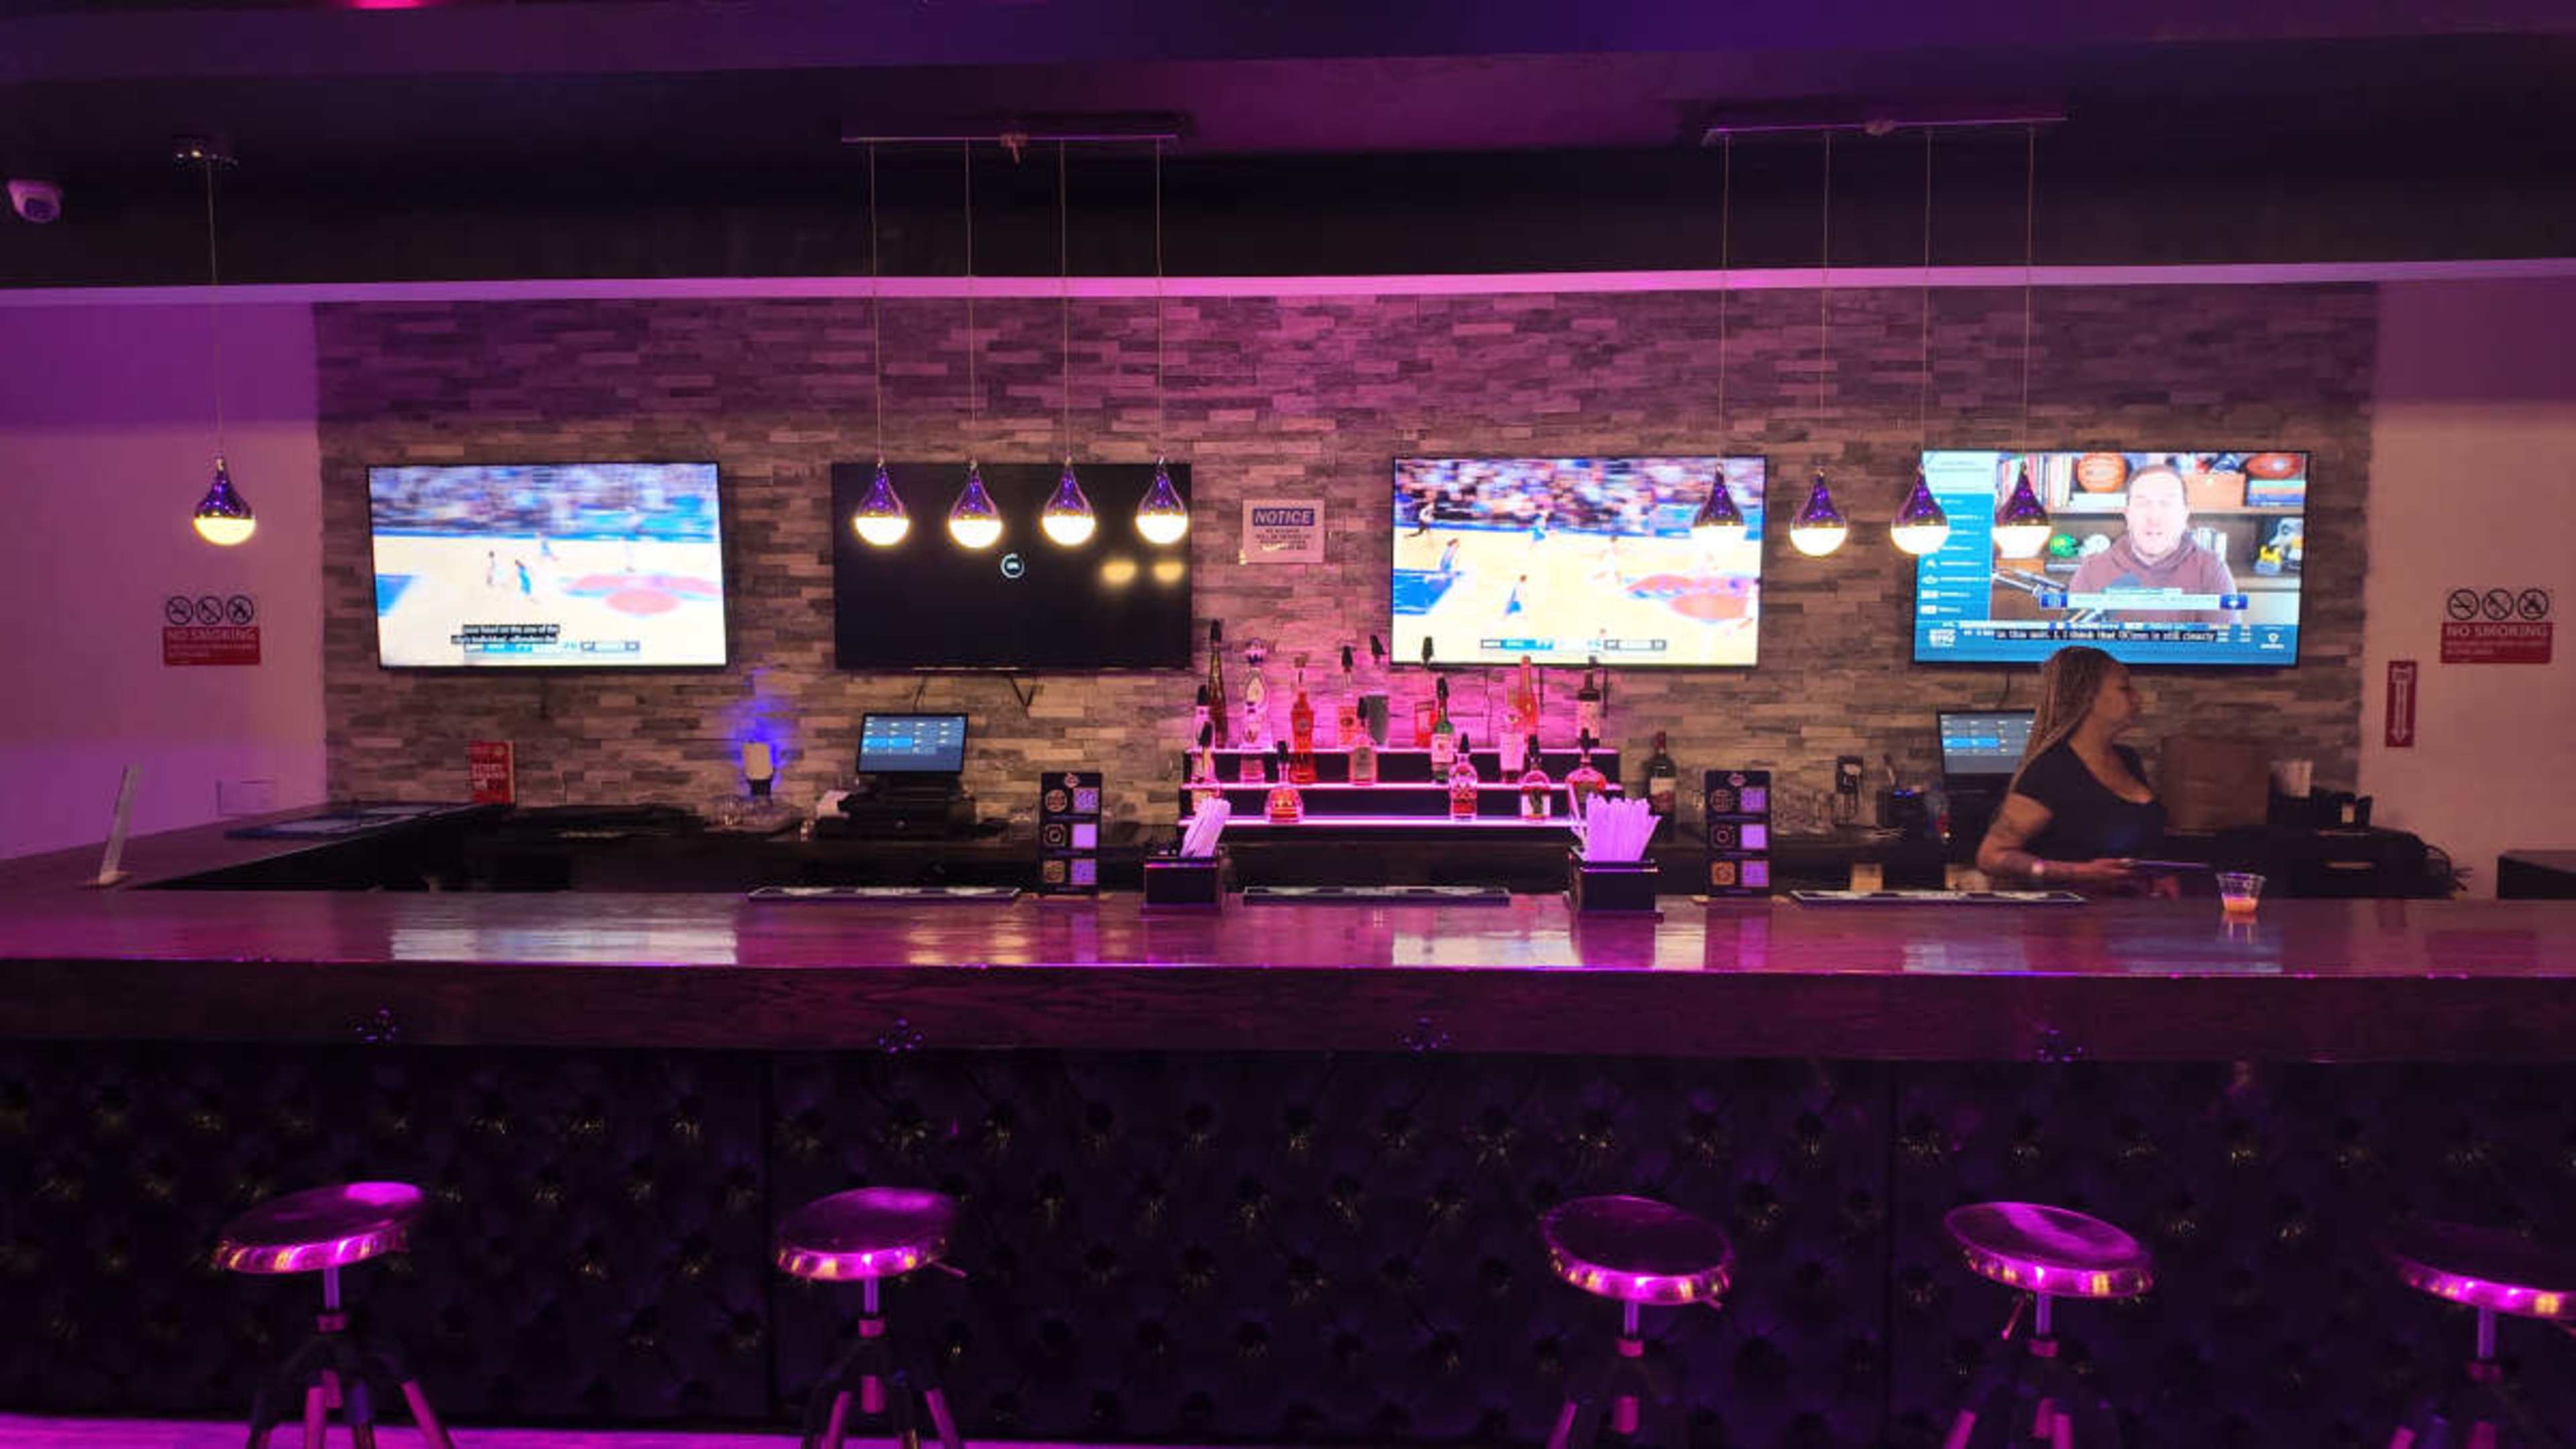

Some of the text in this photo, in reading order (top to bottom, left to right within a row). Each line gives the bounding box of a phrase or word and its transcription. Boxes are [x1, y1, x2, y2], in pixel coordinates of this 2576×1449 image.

[1255, 511, 1311, 524] NOTICE
[2447, 625, 2547, 636] NO SMOKING
